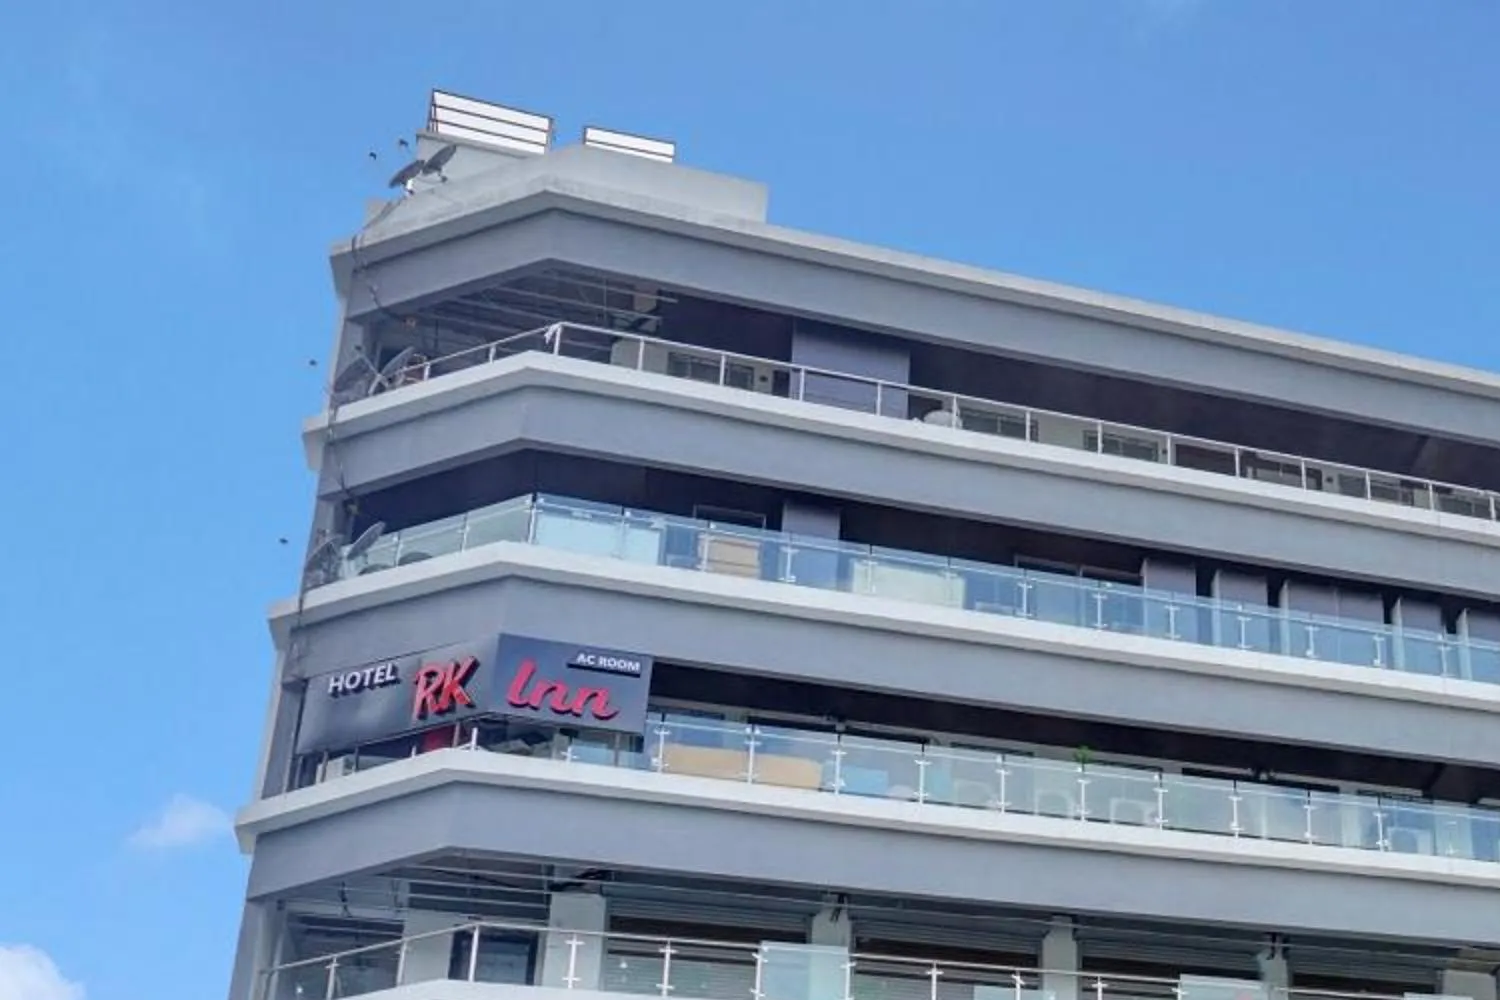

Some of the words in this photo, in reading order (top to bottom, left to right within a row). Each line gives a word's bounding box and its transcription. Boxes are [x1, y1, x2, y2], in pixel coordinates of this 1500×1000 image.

[576, 653, 596, 665] AC
[599, 655, 640, 673] ROOM
[328, 663, 397, 693] HOTEL
[413, 656, 477, 723] RK
[507, 659, 619, 720] Inn
